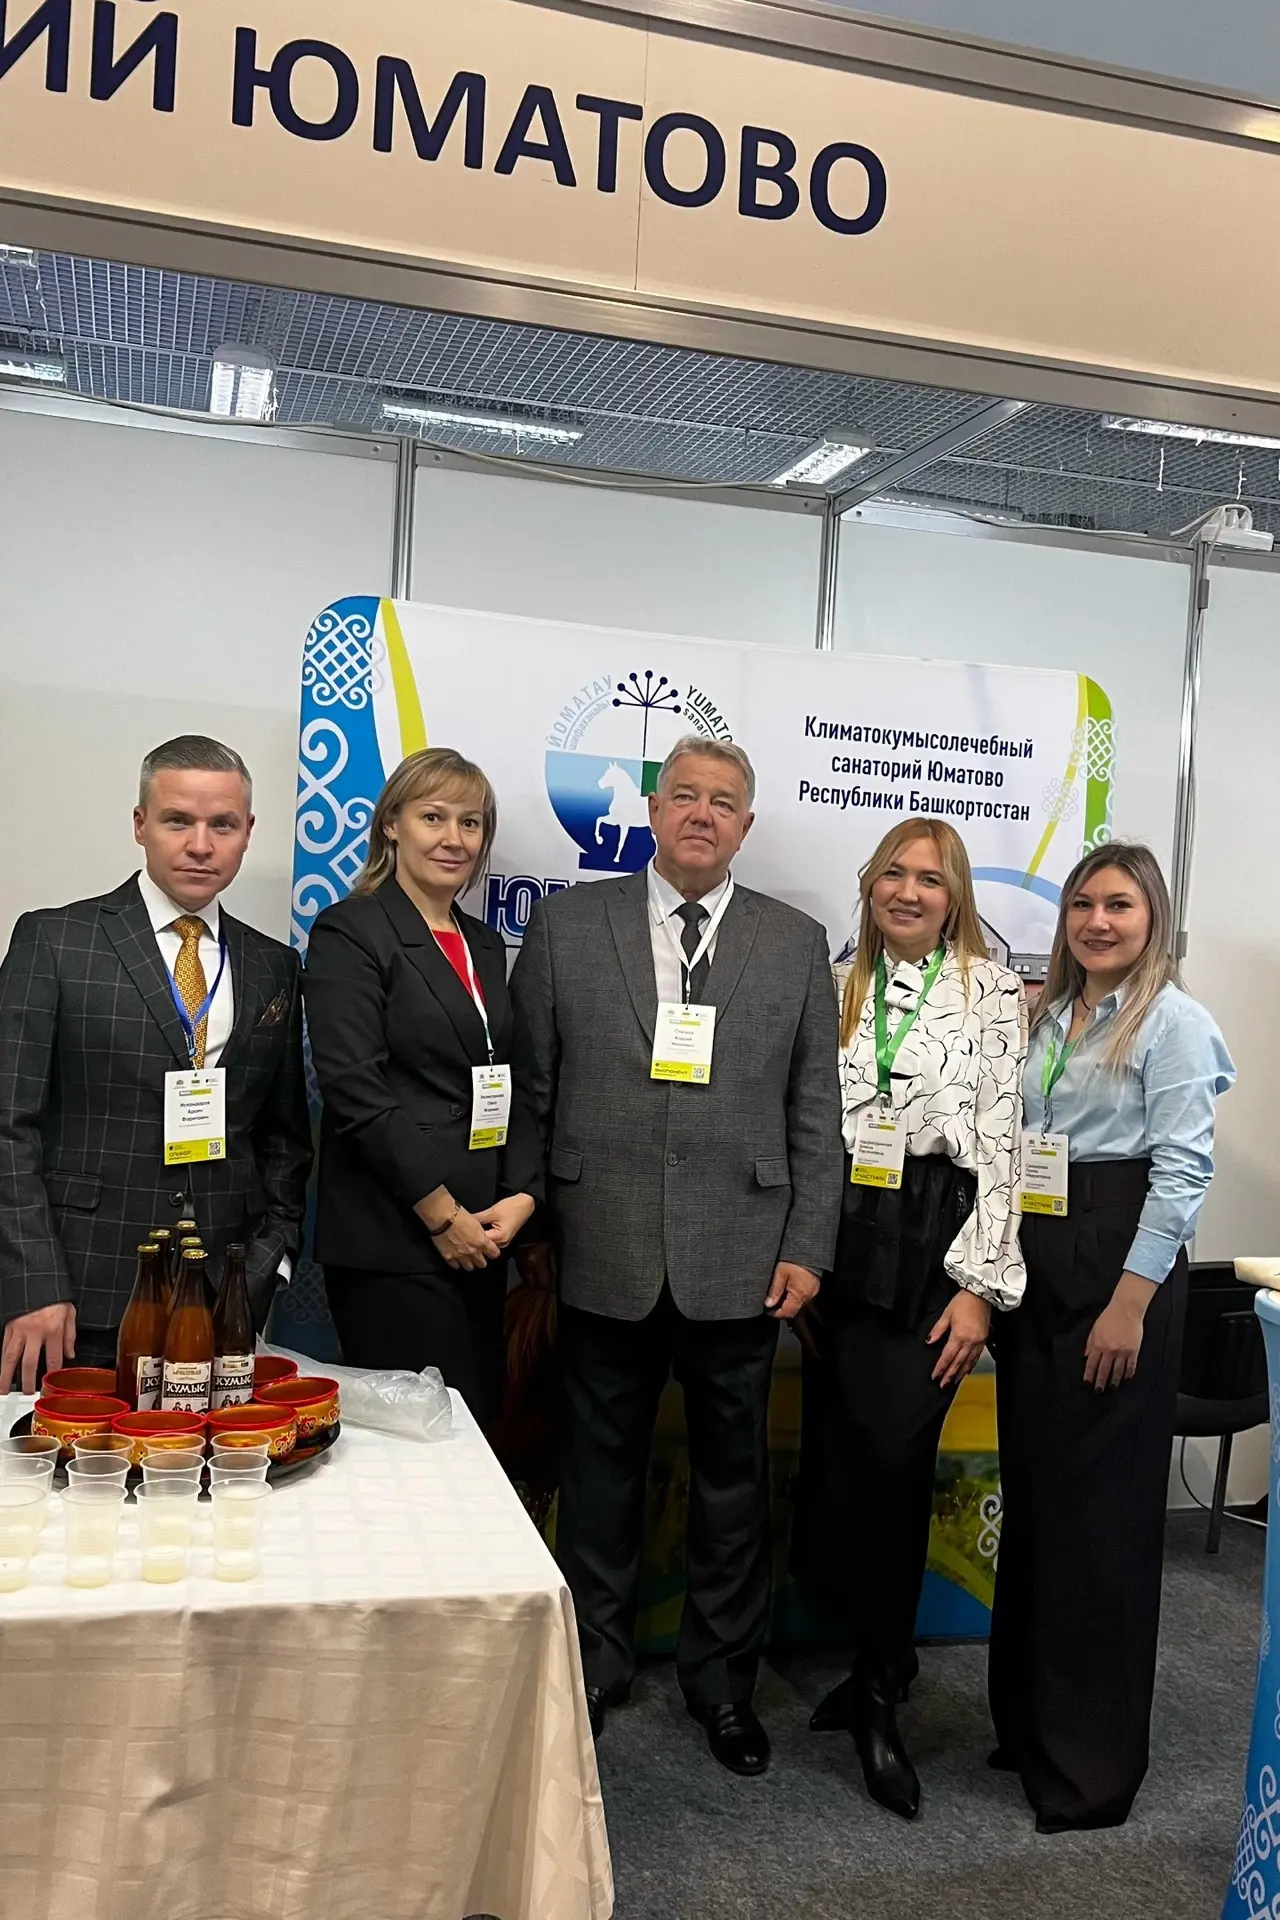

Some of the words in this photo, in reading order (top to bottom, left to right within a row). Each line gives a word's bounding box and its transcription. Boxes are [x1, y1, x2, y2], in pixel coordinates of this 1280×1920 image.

[231, 26, 888, 236] ЮМАТОВО
[804, 715, 1034, 759] Климатокумысолечебный
[831, 755, 922, 782] санаторий
[927, 760, 1004, 788] Юматово
[799, 780, 904, 811] Республики
[909, 791, 1030, 821] Башкортостан
[167, 1383, 205, 1394] КУМЫС
[214, 1375, 252, 1386] КУМЫС
